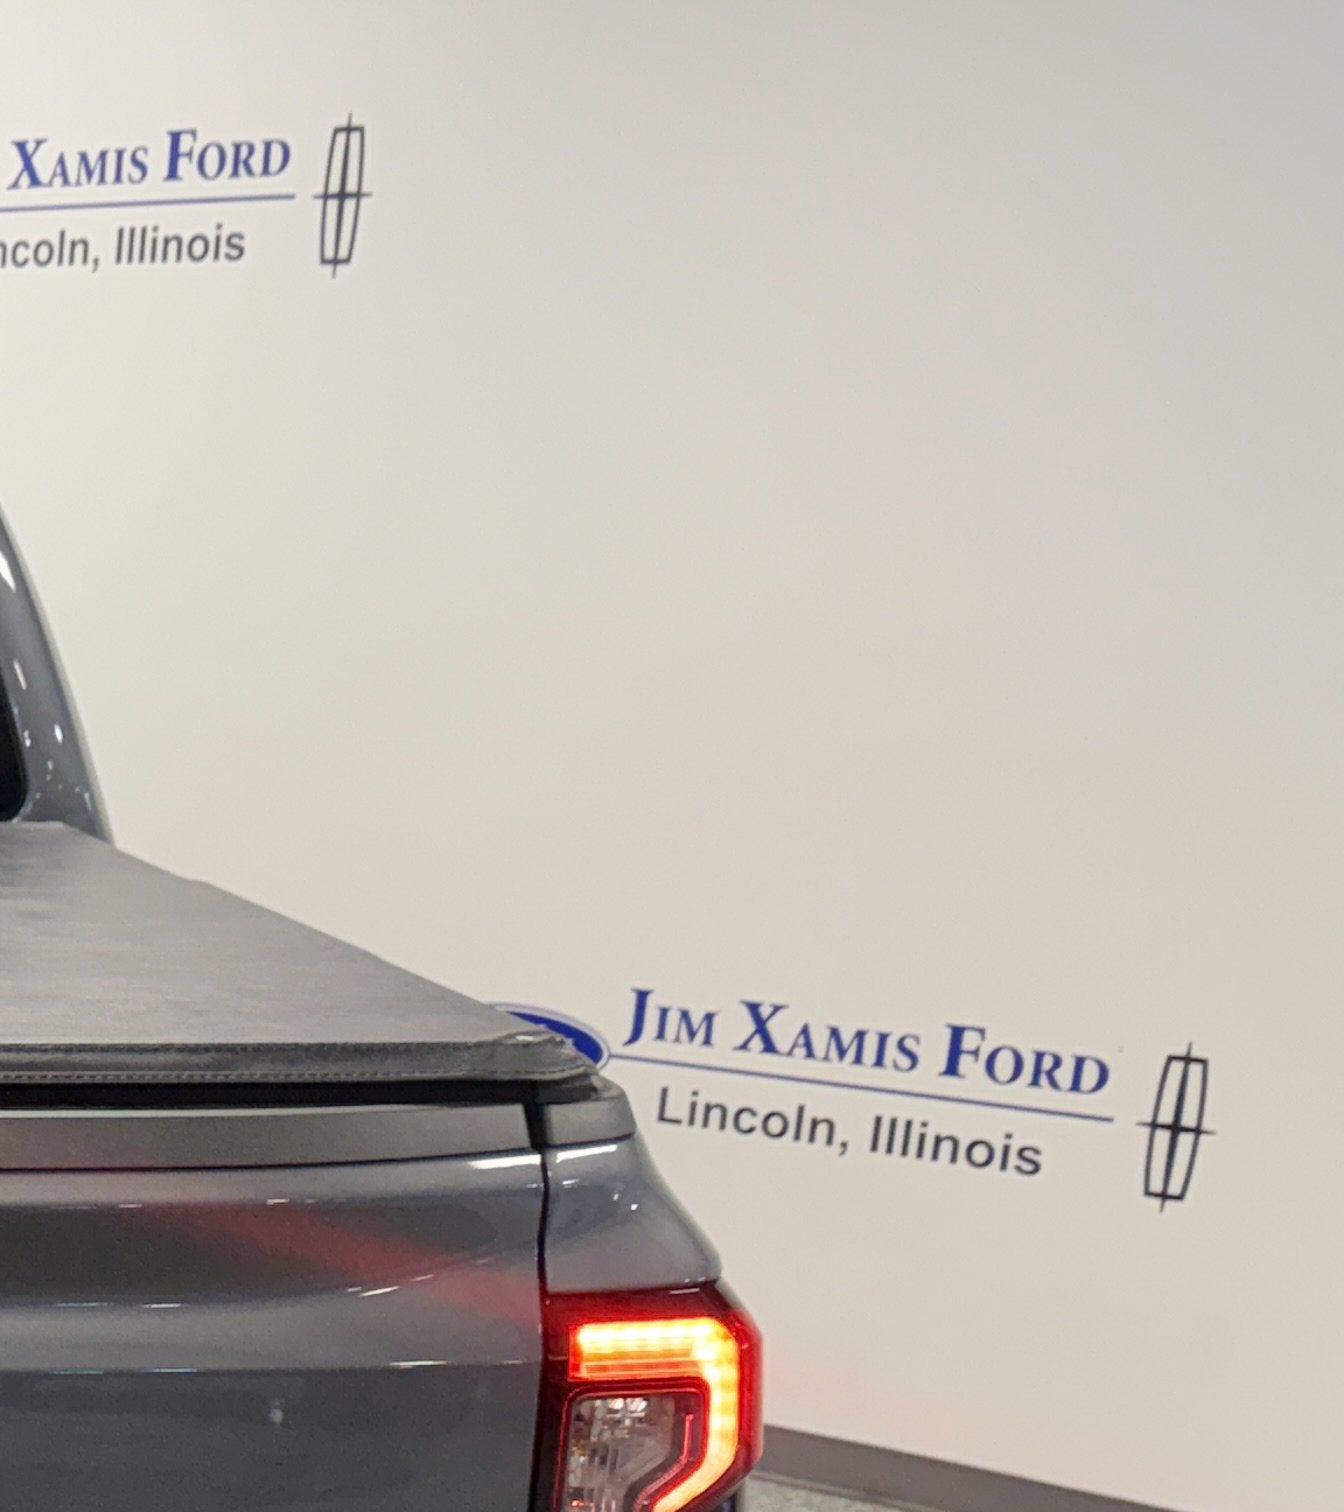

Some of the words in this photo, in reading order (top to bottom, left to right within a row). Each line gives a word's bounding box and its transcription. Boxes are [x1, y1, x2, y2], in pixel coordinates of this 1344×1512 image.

[7, 138, 148, 190] XAMIS
[163, 129, 291, 182] FORD
[115, 223, 245, 265] Illinois
[623, 988, 717, 1048] JIM
[733, 1000, 920, 1074] XAMIS
[938, 1024, 1110, 1097] FORD
[657, 1086, 850, 1156] Lincoln,
[869, 1115, 1043, 1177] Illinois
